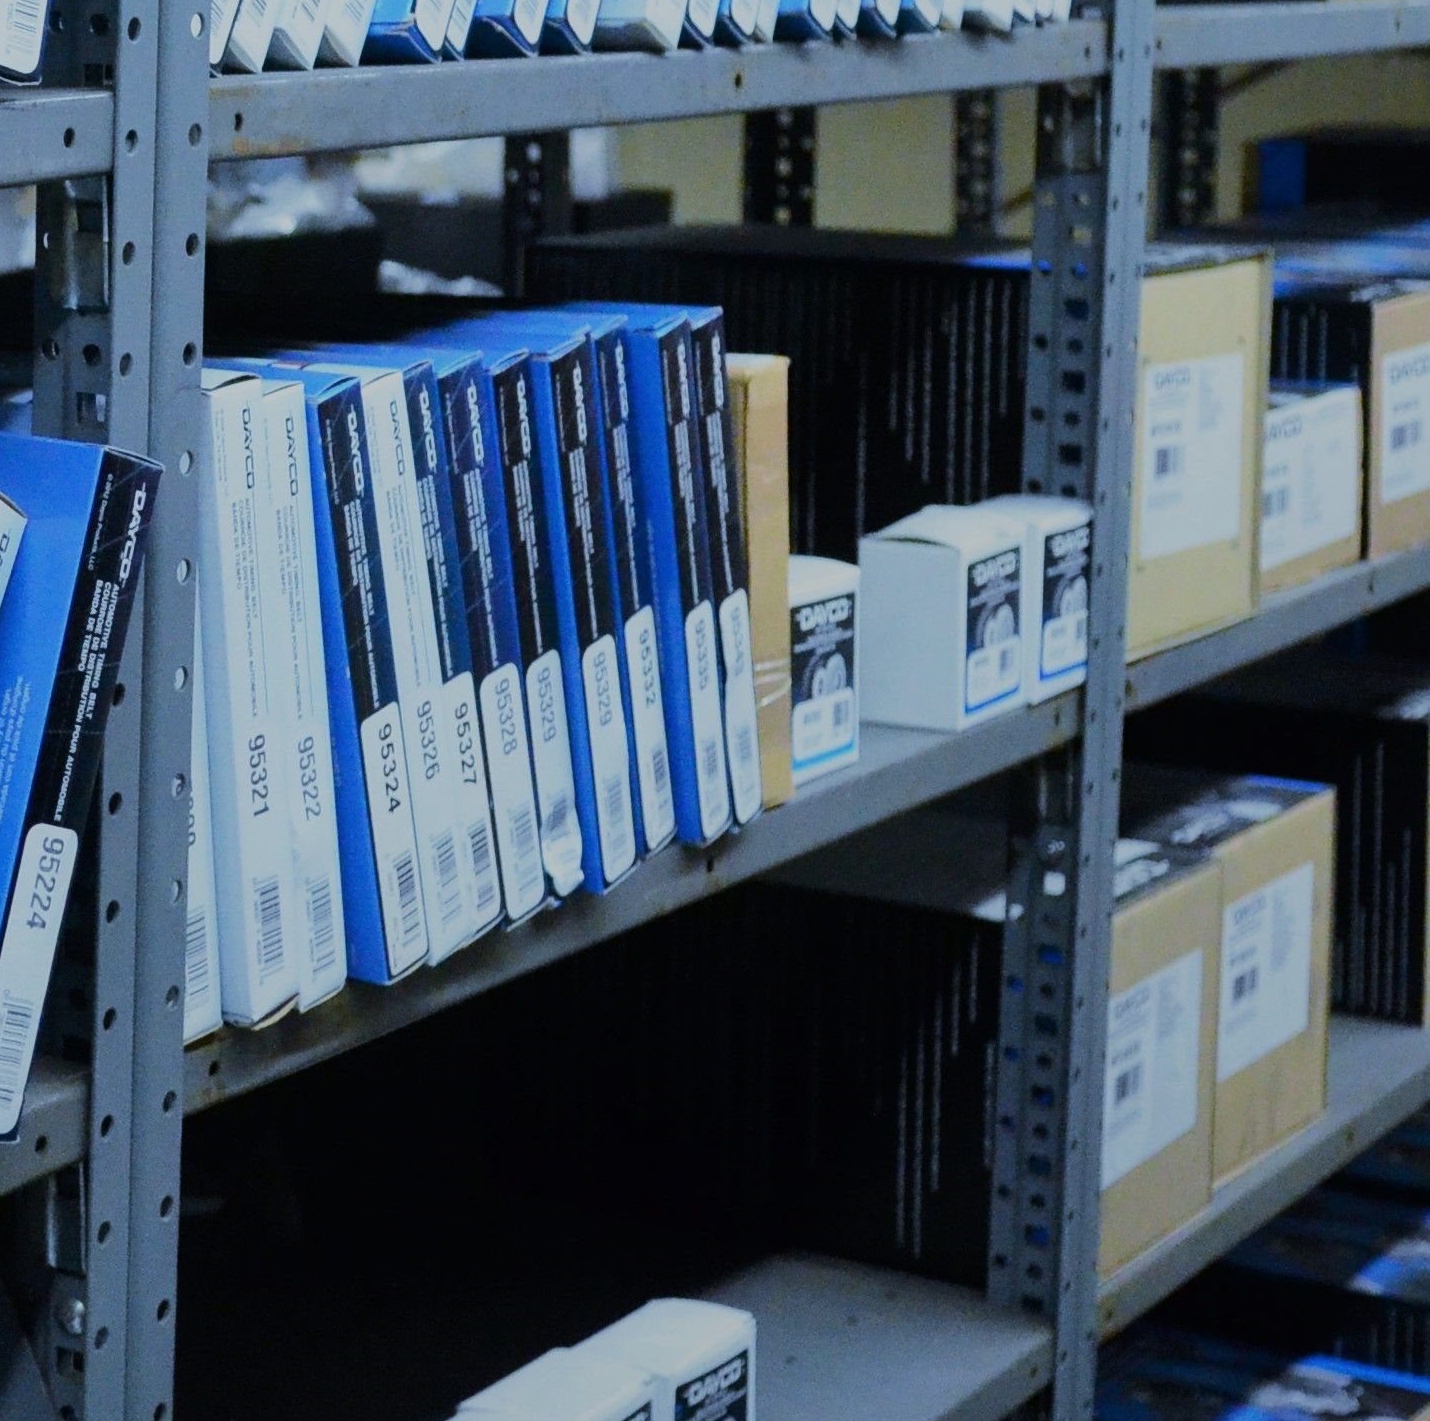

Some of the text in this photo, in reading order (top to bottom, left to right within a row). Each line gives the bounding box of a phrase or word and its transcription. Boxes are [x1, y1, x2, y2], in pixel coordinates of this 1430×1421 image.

[241, 406, 256, 490] DAYCO
[284, 416, 300, 497] DAYCO
[345, 410, 364, 490] DAYCO
[466, 382, 486, 461] DAYCO
[118, 490, 147, 581] DAYCO
[77, 579, 103, 672] BANDA DE TIEMPO
[84, 584, 121, 719] AUTOMOTIVE TIMING BELT
[53, 583, 112, 822] COURROIE DE DISTRIBUTION POUR AUTOMOBILE
[494, 677, 520, 755] 95328
[538, 666, 561, 743] 95329
[591, 651, 616, 726] 95329
[247, 732, 272, 817] 95321
[296, 735, 325, 820] 95322
[377, 721, 404, 814] 95324
[417, 700, 443, 780] 95326
[453, 700, 480, 786] 95327
[26, 835, 65, 930] 95224
[683, 1359, 743, 1405] DAYCO
